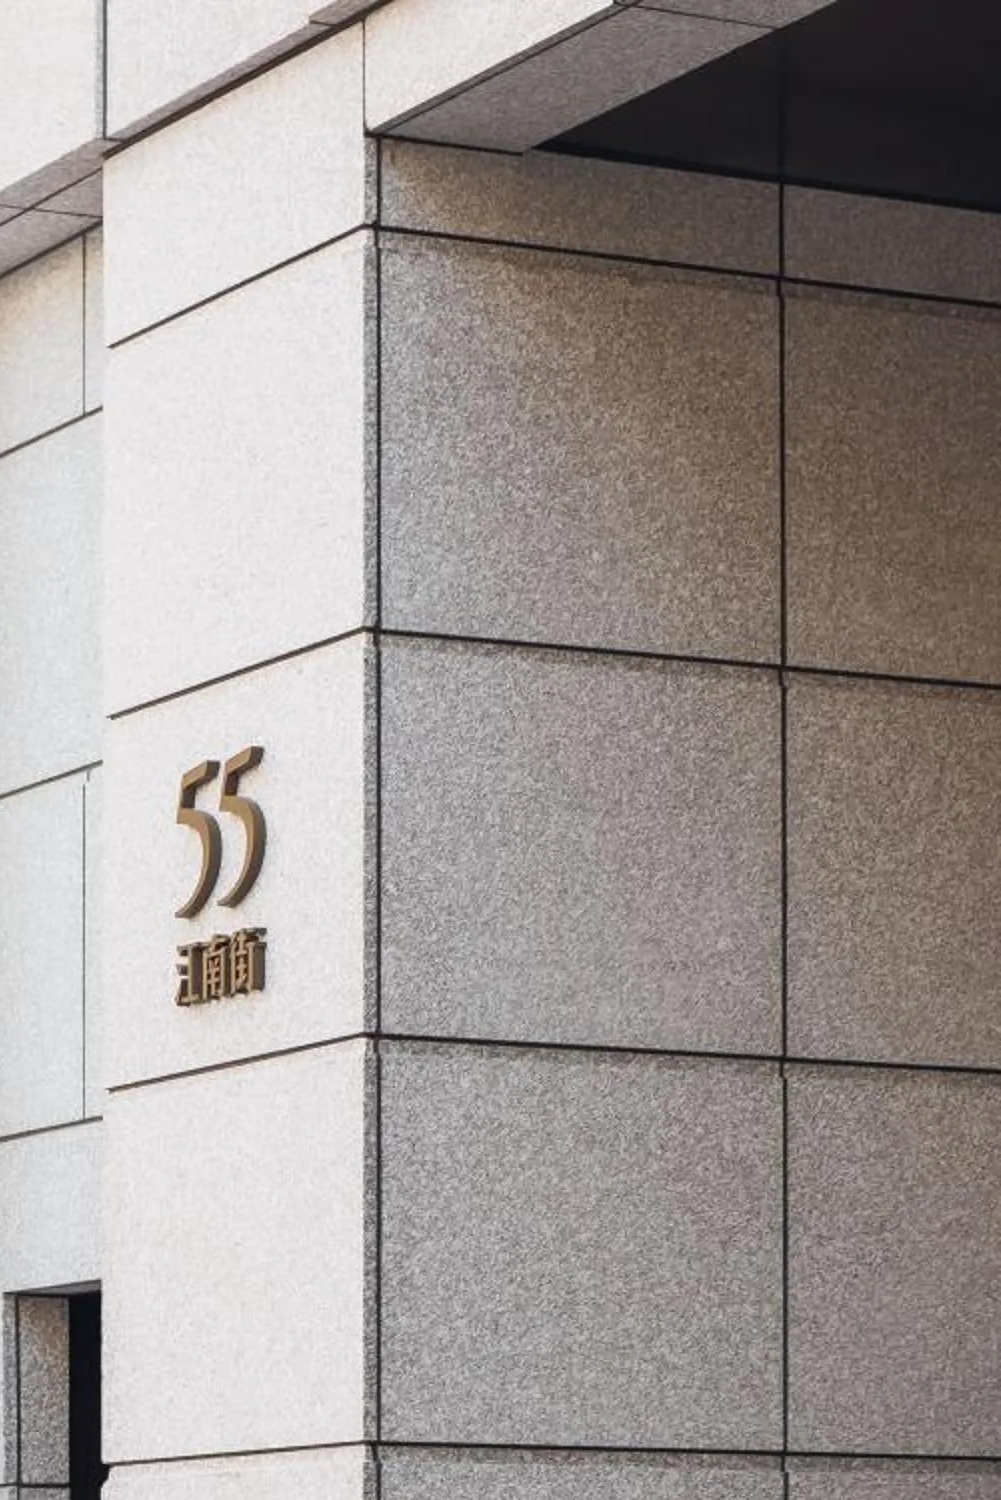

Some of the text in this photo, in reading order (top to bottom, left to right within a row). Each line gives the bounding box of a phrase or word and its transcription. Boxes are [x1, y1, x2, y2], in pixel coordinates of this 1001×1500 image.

[175, 745, 266, 918] 55
[175, 927, 268, 1006] 江南街
